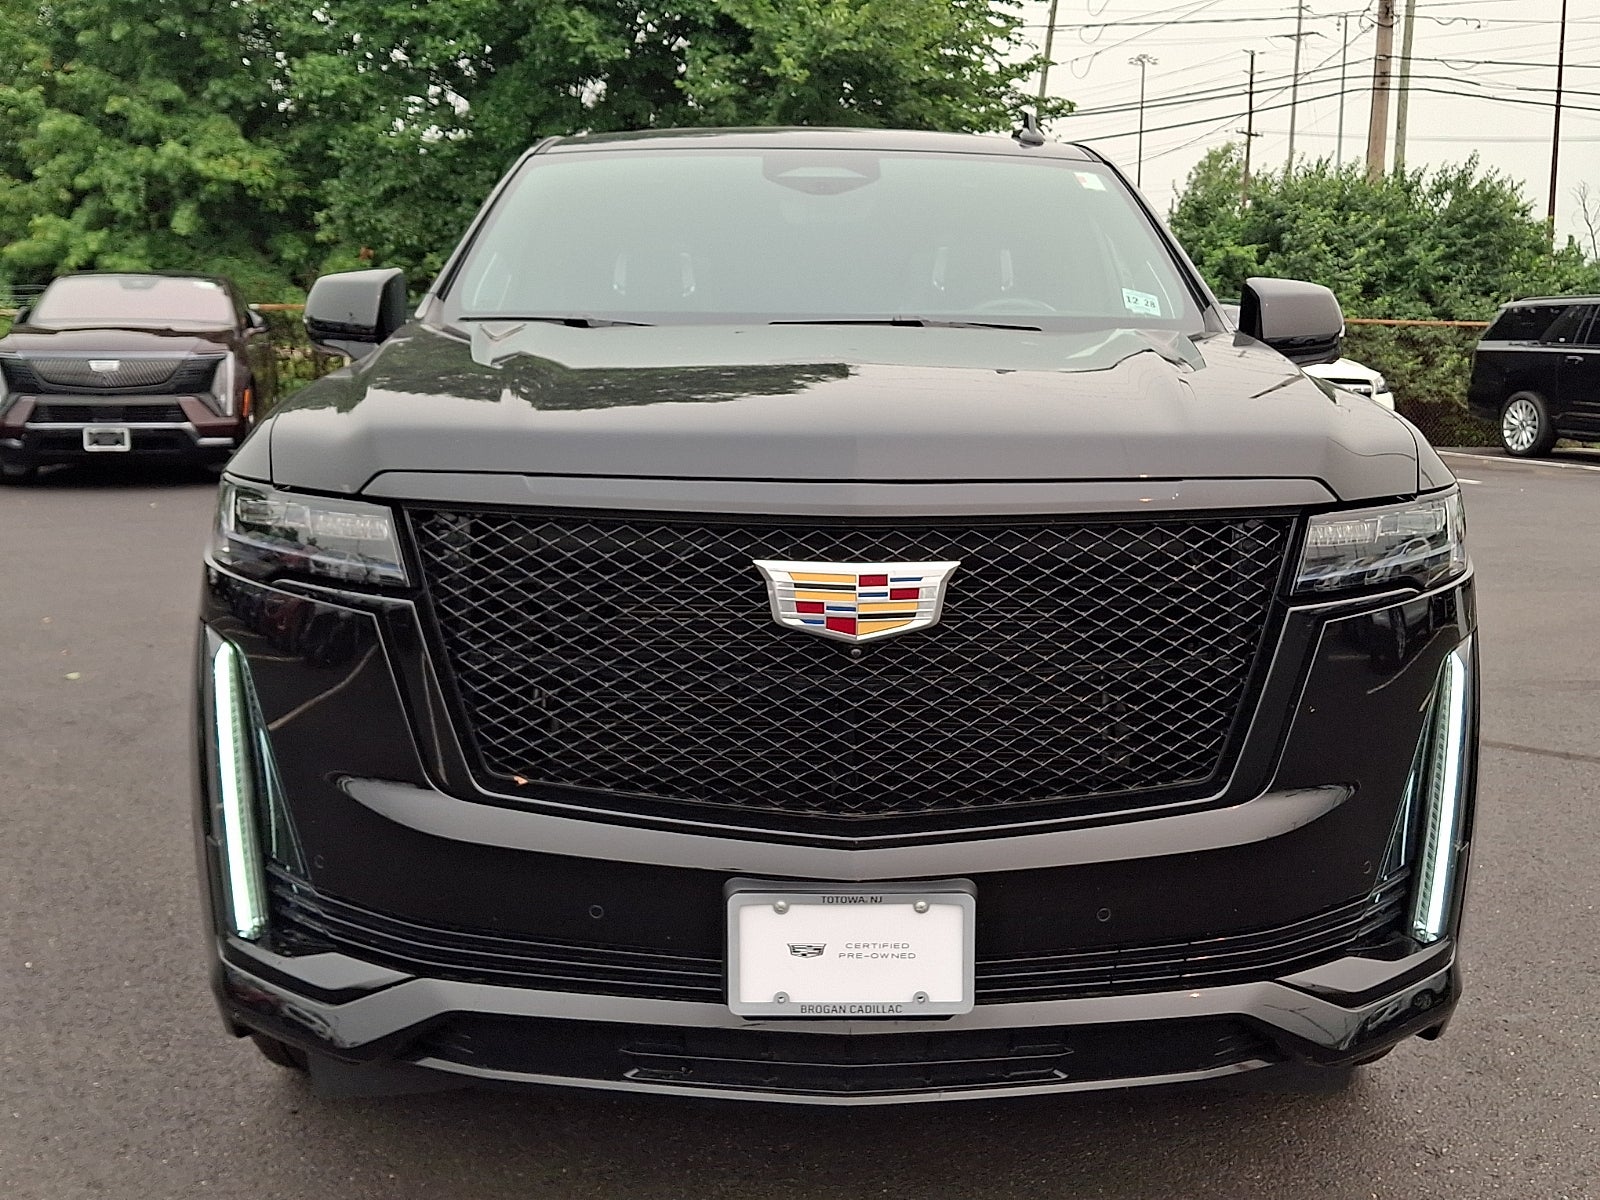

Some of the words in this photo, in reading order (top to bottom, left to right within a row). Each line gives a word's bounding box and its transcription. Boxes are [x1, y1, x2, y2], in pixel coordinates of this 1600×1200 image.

[1126, 295, 1139, 305] 12
[870, 895, 883, 904] NJ
[800, 1004, 847, 1014] BROGAN
[849, 1004, 903, 1014] CADILLAC
